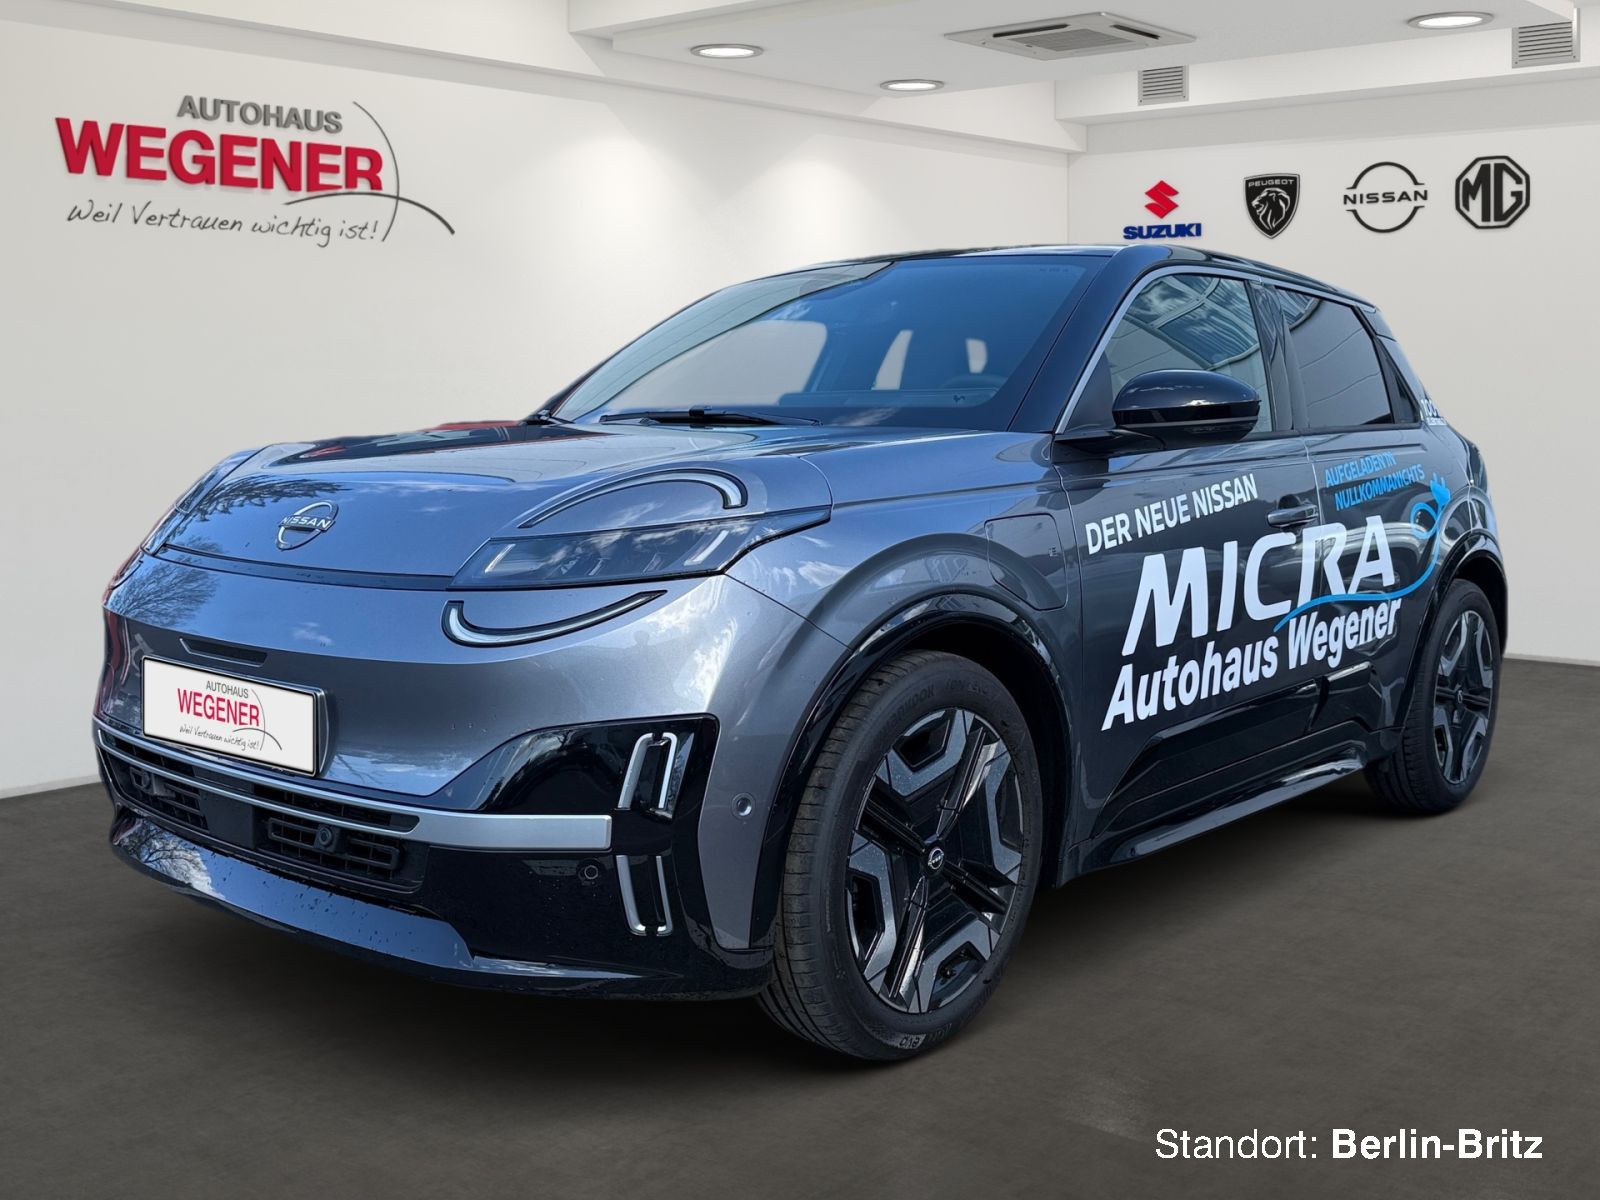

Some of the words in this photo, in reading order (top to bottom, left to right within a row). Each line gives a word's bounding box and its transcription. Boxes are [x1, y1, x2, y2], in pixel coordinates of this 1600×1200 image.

[177, 95, 343, 133] AUTOHAUS
[55, 117, 383, 193] WEGENER
[1248, 179, 1294, 187] PEUGEOT
[1343, 189, 1428, 206] NISSAN
[1462, 162, 1523, 223] MG
[67, 199, 122, 223] Weil
[132, 200, 242, 233] Vertrauen
[251, 215, 332, 248] wichtig
[338, 219, 379, 241] ist!
[1123, 222, 1202, 240] SUZUKI
[1325, 453, 1386, 488] AUFGELADEN
[1334, 464, 1425, 511] NULLKOMMANICHTS
[280, 515, 331, 528] NISSAN
[1085, 512, 1132, 555] DER
[1134, 494, 1192, 540] NEUE
[1191, 473, 1258, 520] NISSAN
[1121, 515, 1396, 657] MICRA
[1101, 631, 1279, 732] Autohaus
[1287, 596, 1402, 670] Wegener
[177, 688, 260, 727] WEGENER
[205, 680, 249, 699] AUTOHAUS
[179, 724, 193, 735] Weil
[194, 726, 223, 741] Vertrauen
[224, 735, 246, 751] wichtig
